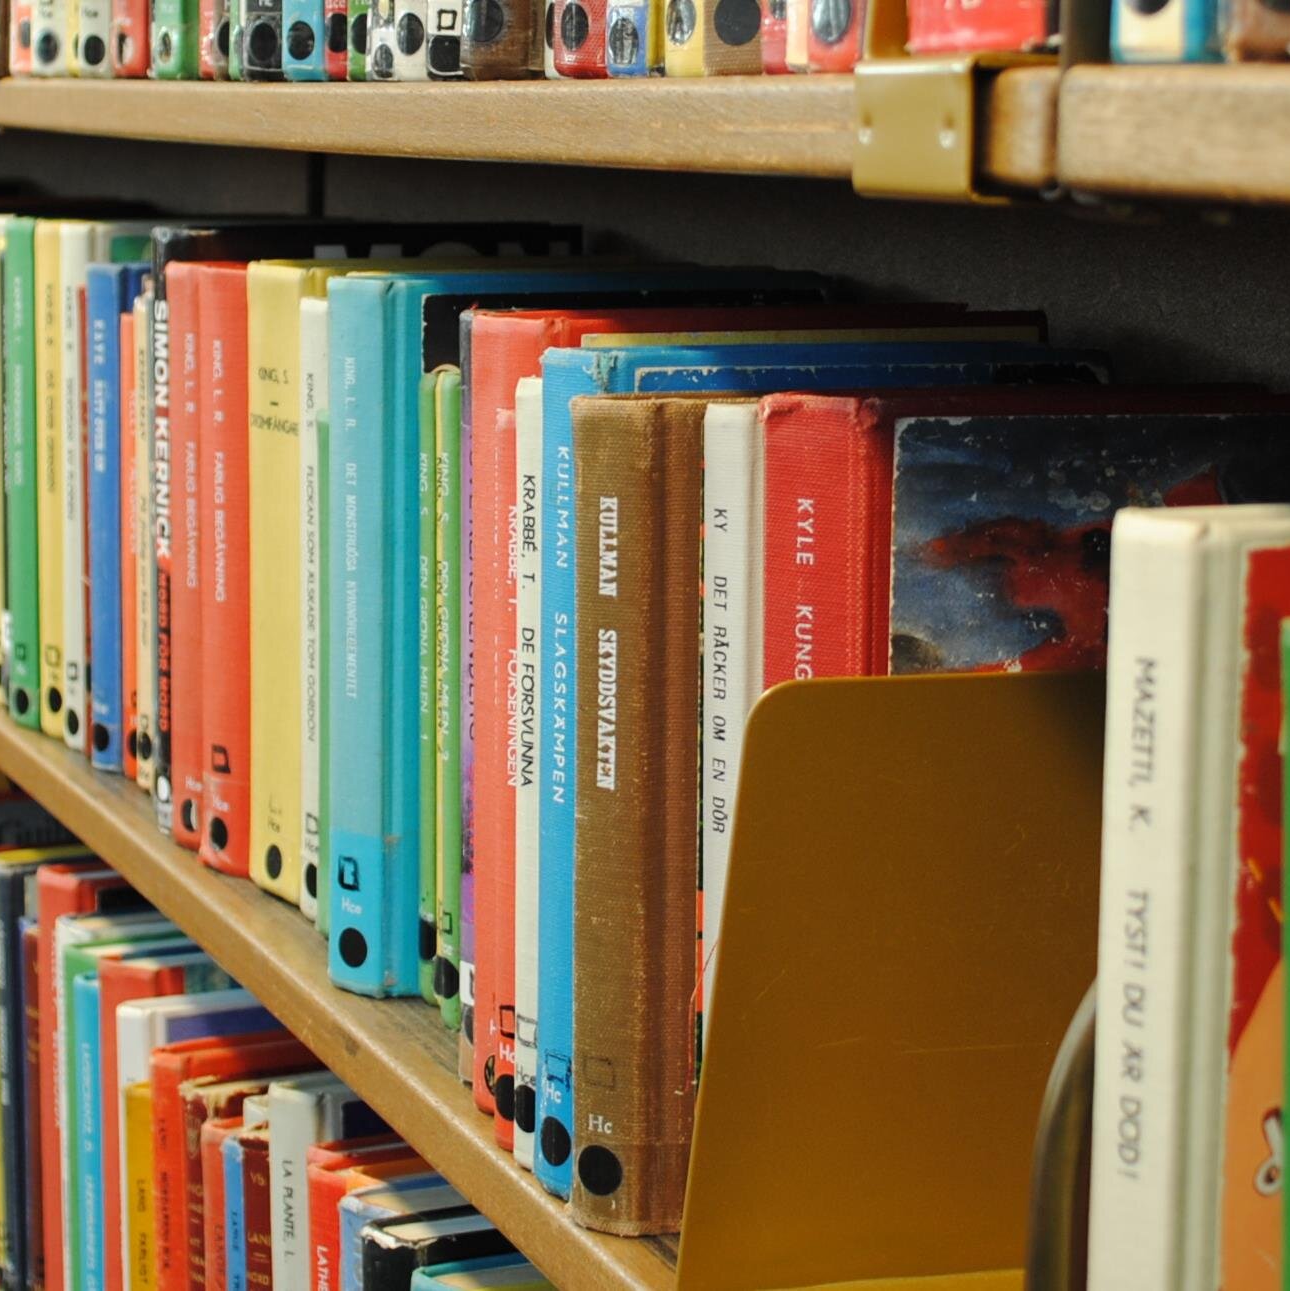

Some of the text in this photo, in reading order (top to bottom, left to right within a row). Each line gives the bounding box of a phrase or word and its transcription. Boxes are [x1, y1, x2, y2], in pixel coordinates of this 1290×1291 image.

[212, 339, 223, 381] KING,
[344, 357, 357, 389] KING,
[154, 299, 171, 559] SIMON KERNICK
[186, 441, 197, 492] FARLIG
[214, 451, 225, 503] FARLIG
[345, 462, 357, 485] DET
[714, 508, 727, 532] KY
[796, 498, 814, 566] KYLE
[215, 510, 227, 602] BEGÅVNING
[713, 576, 727, 611] DET
[521, 475, 536, 787] KRABBÉ, T. DE FÖRSVUNNA
[553, 446, 569, 804] KULLMAN SLAGSKÄMPEN
[597, 496, 618, 790] KULLMAN SKYDDSVAKTEN
[307, 638, 316, 670] TOM
[307, 675, 316, 743] GORDON
[419, 666, 428, 713] MILEN
[712, 715, 726, 741] OM
[1128, 657, 1156, 787] MAZETTI,
[712, 757, 726, 782] EN
[1128, 805, 1152, 832] K.
[341, 896, 362, 915] Hce
[1124, 890, 1150, 970] TYST!
[1122, 983, 1146, 1028] DU
[516, 1064, 538, 1087] Hce
[545, 1083, 562, 1105] Hc
[588, 1114, 613, 1134] Hc
[282, 1160, 293, 1177] LA
[282, 1187, 295, 1242] PLANTE,
